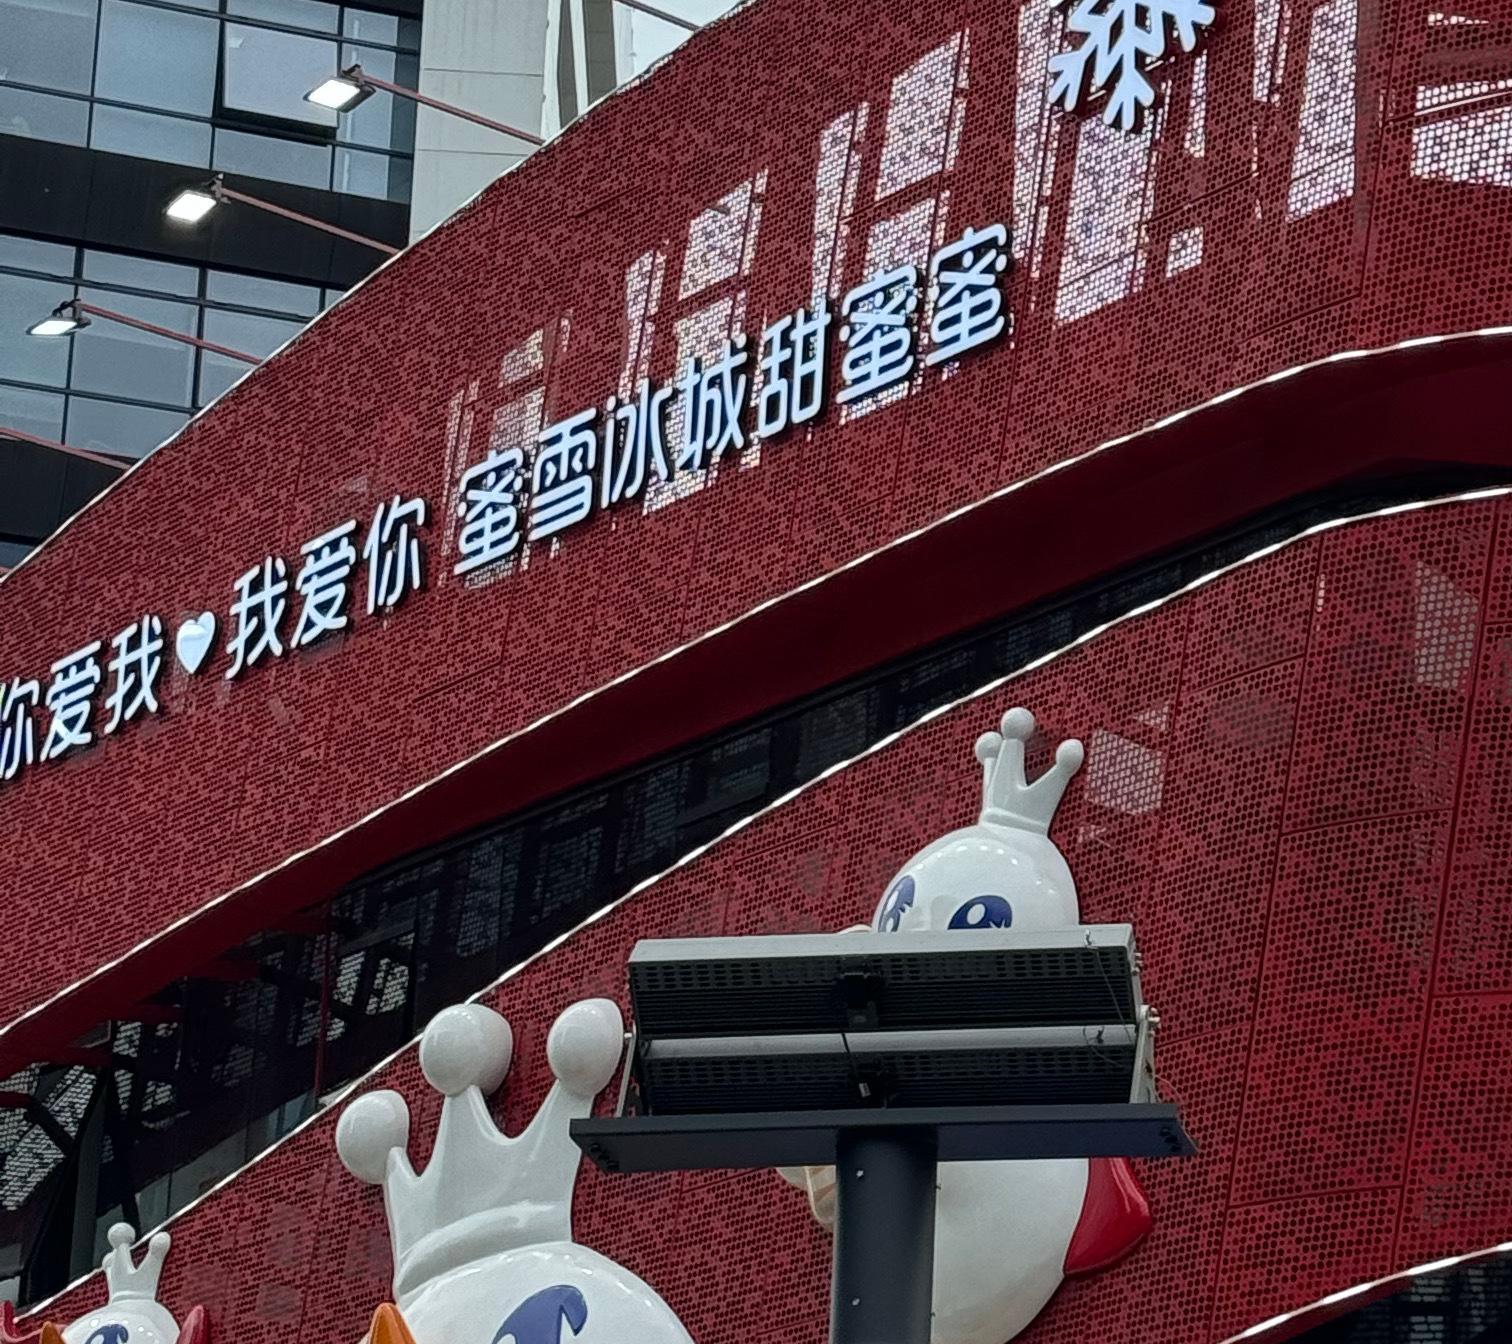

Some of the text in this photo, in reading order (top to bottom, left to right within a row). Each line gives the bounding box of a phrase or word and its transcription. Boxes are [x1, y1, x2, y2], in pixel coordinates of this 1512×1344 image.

[0, 224, 1007, 780] 你爱我 我爱你 蜜雪冰城甜蜜蜜
